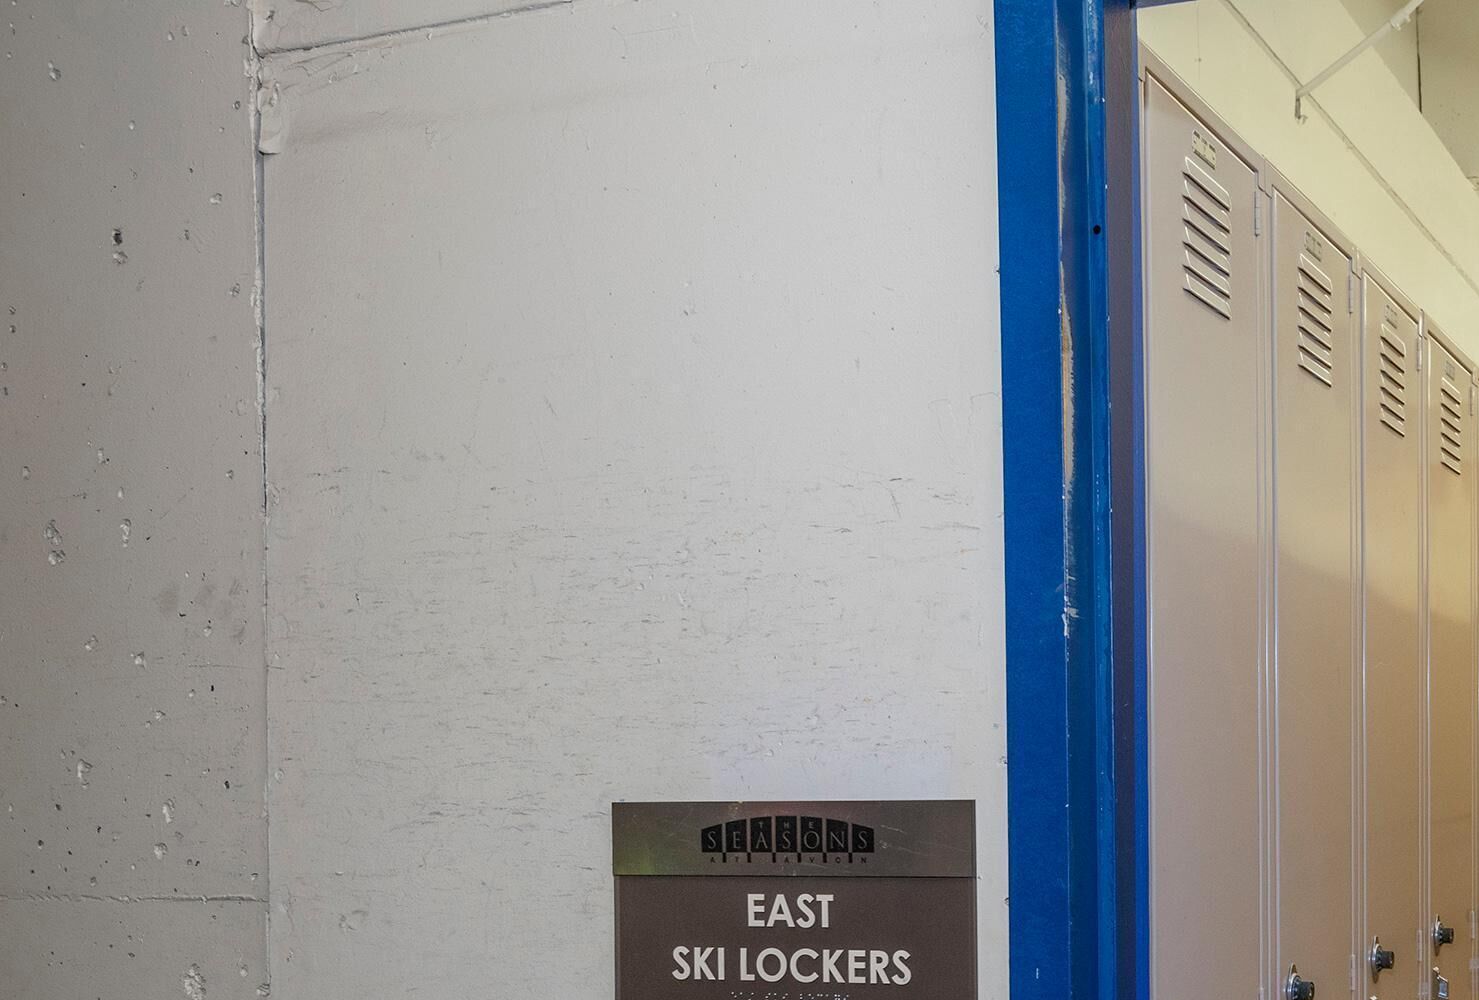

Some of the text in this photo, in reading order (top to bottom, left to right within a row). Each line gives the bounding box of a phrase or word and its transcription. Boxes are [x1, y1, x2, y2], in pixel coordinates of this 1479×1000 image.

[758, 821, 814, 829] THE
[707, 830, 868, 850] SEASONS
[747, 893, 834, 928] EAST
[672, 945, 912, 985] SKI LOCKERS
